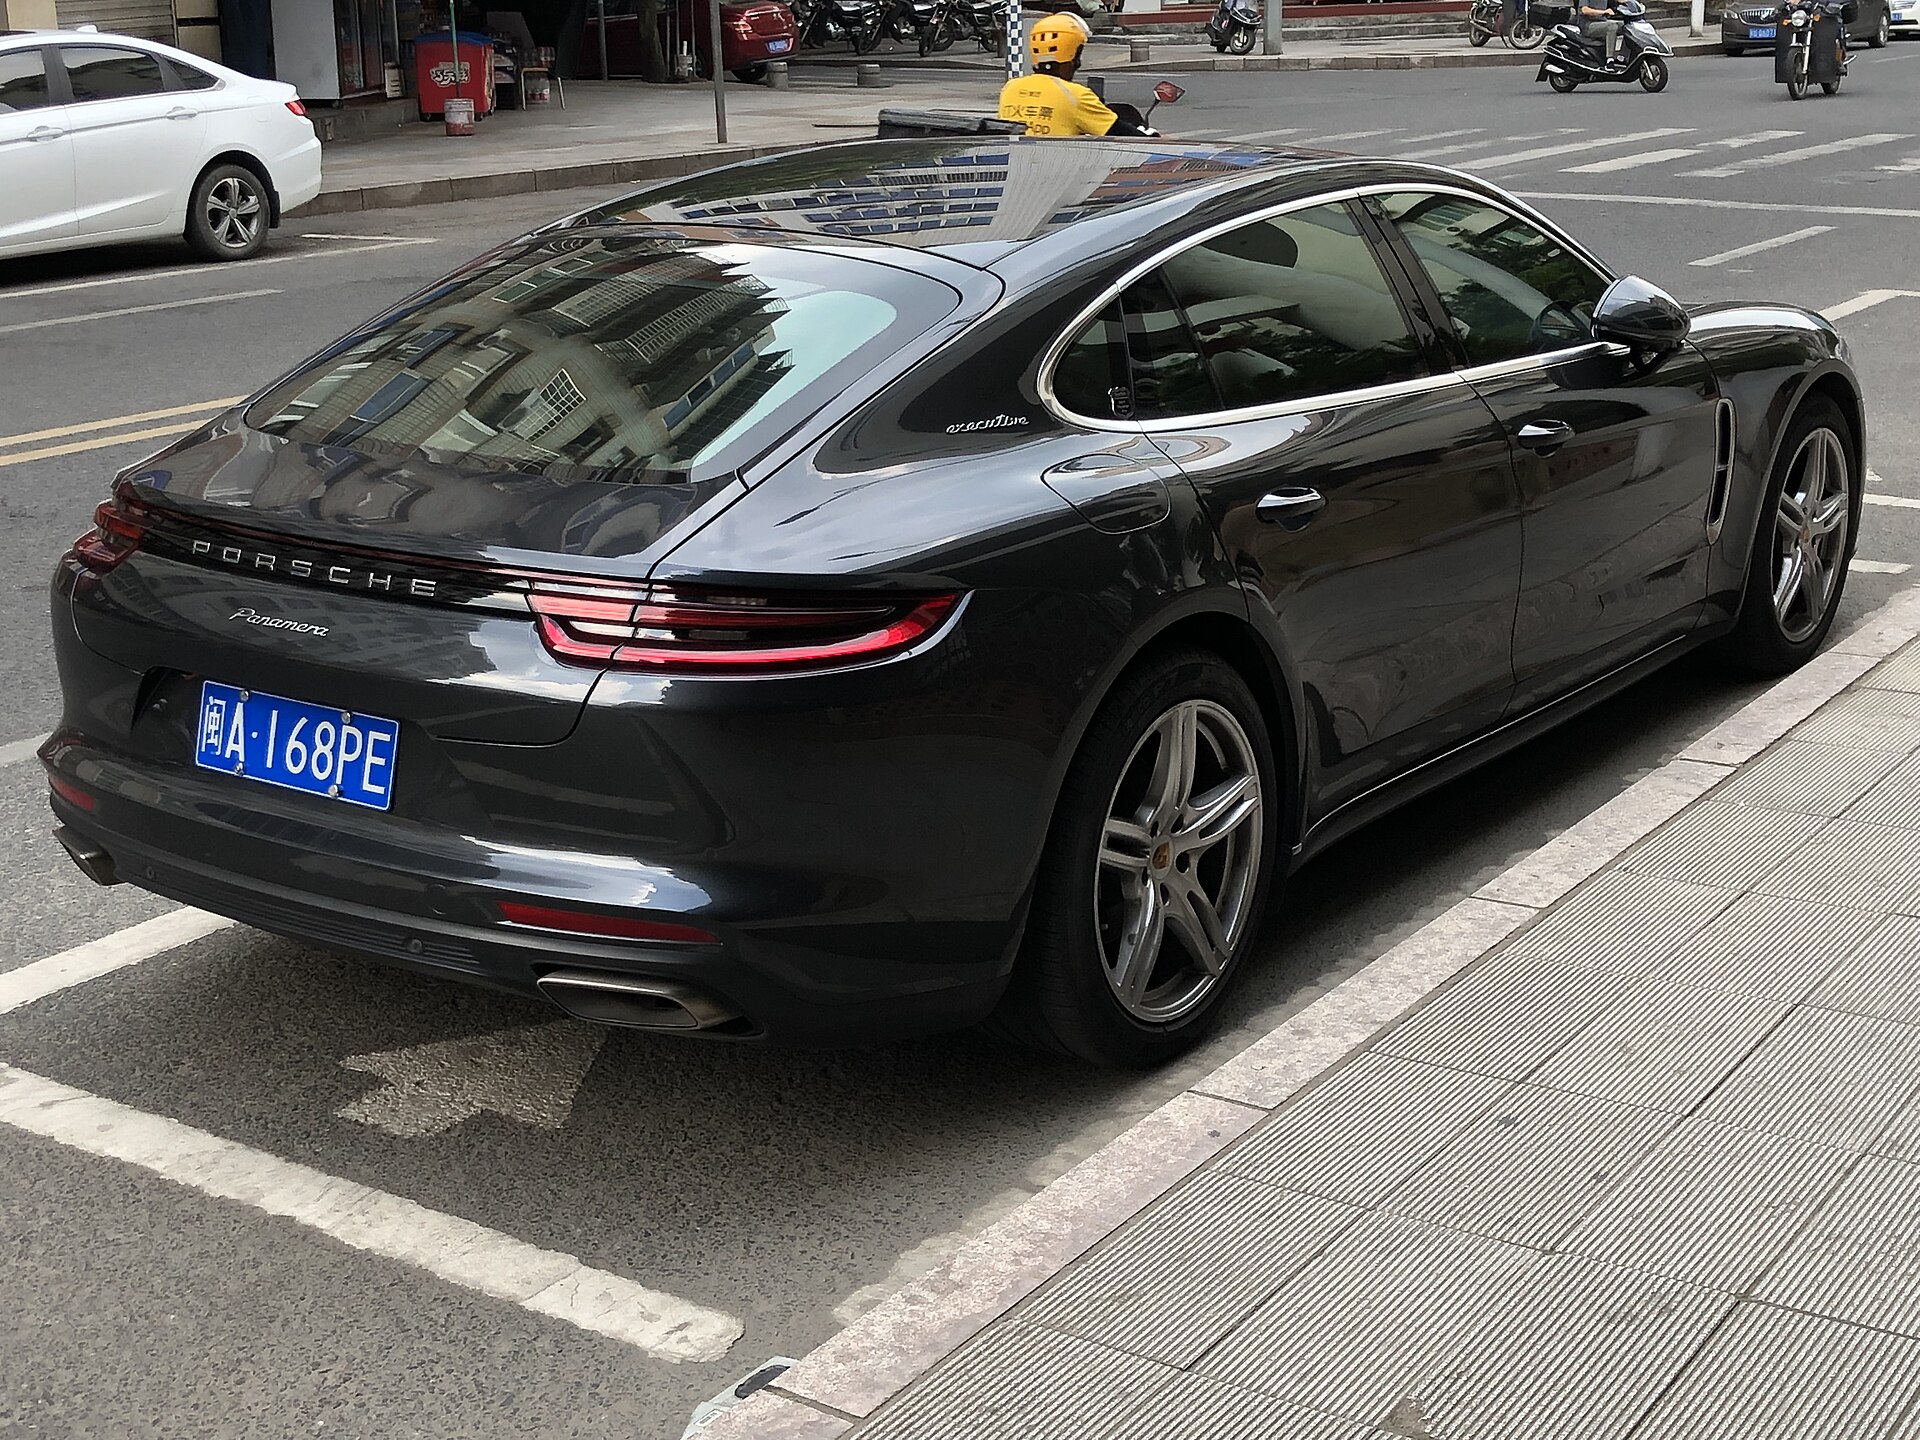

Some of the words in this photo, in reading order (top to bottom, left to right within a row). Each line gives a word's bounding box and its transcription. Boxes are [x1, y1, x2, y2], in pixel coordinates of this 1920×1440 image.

[945, 413, 1030, 434] executive
[192, 539, 437, 598] PORSCHE
[228, 607, 330, 638] Panamera
